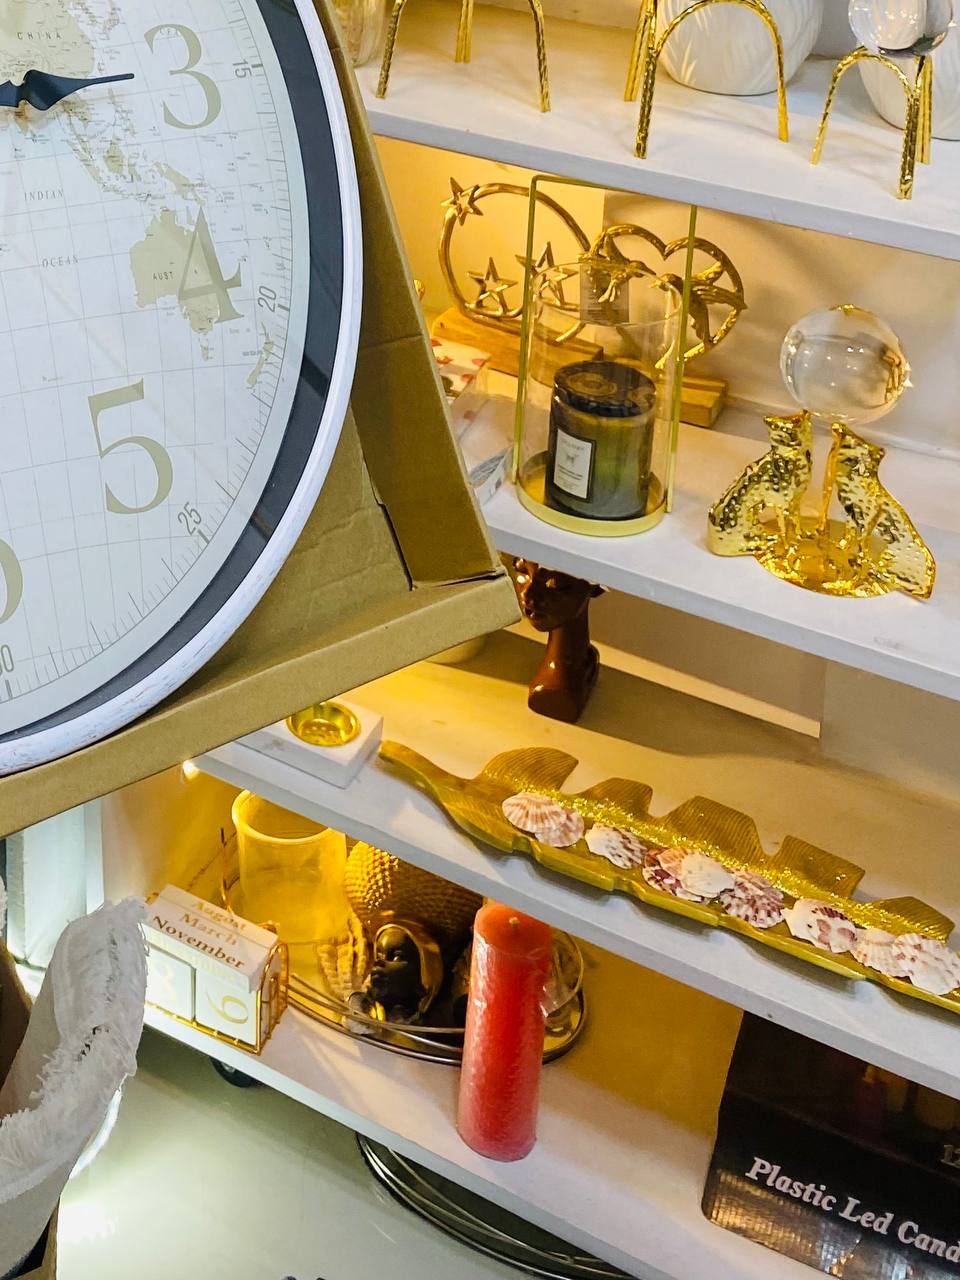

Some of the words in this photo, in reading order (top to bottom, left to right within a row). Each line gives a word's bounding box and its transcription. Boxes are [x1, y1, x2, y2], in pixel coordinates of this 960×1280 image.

[16, 31, 62, 41] CHINA
[143, 23, 223, 131] 3
[231, 58, 253, 80] 15
[23, 187, 65, 202] INDIAN
[41, 254, 80, 269] OCEAN
[177, 205, 245, 325] 4
[256, 285, 278, 314] 20
[87, 377, 174, 515] 5
[176, 503, 203, 536] 25
[152, 915, 246, 969] November
[180, 913, 238, 946] March
[744, 1156, 837, 1211] Plastic
[838, 1196, 895, 1236] Led
